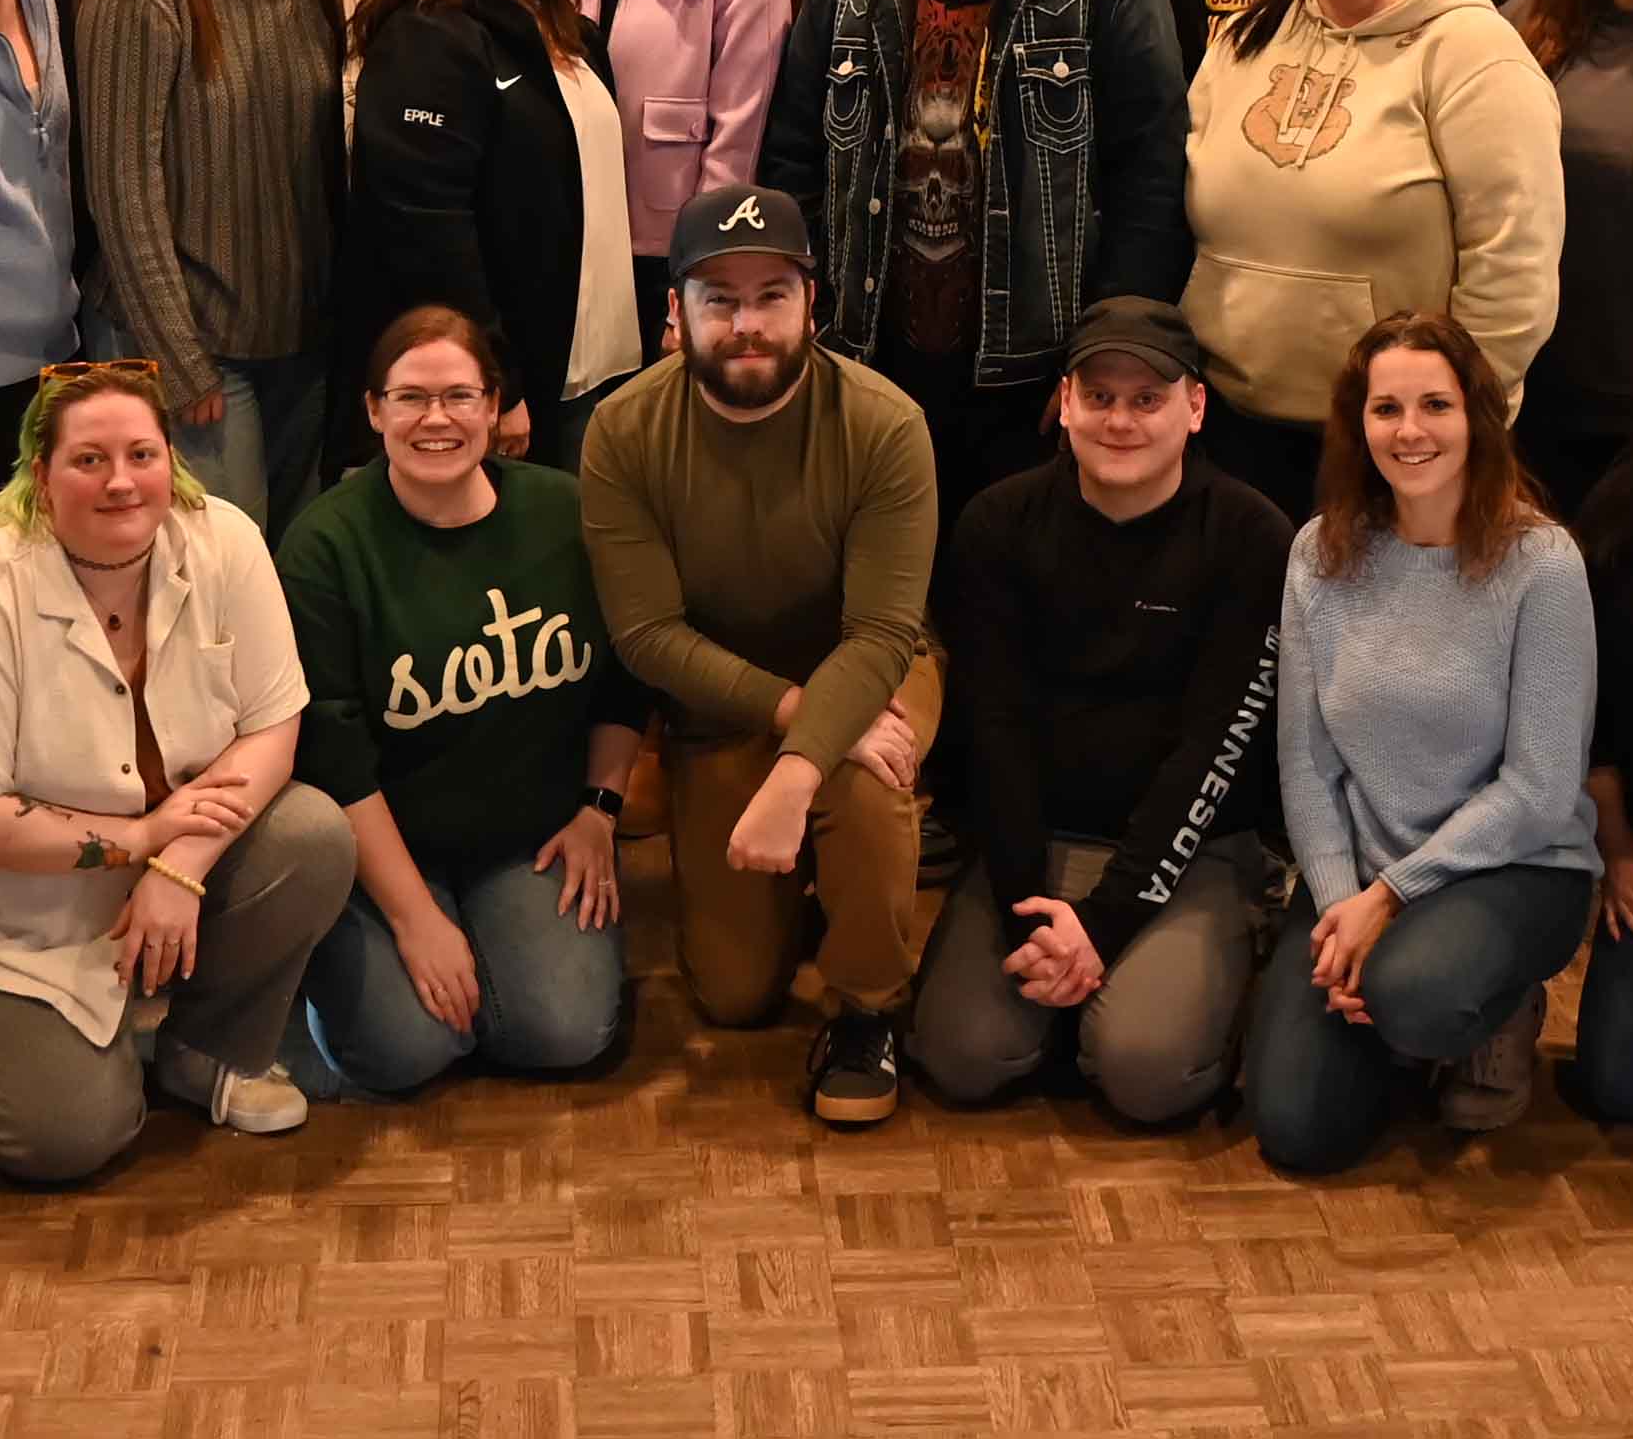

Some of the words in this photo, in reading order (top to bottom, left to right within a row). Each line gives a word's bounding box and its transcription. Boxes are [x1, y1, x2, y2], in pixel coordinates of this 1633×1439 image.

[403, 107, 446, 128] EPPLE
[718, 195, 766, 231] A
[383, 588, 592, 730] sota
[1136, 656, 1280, 905] MINNESOTA
